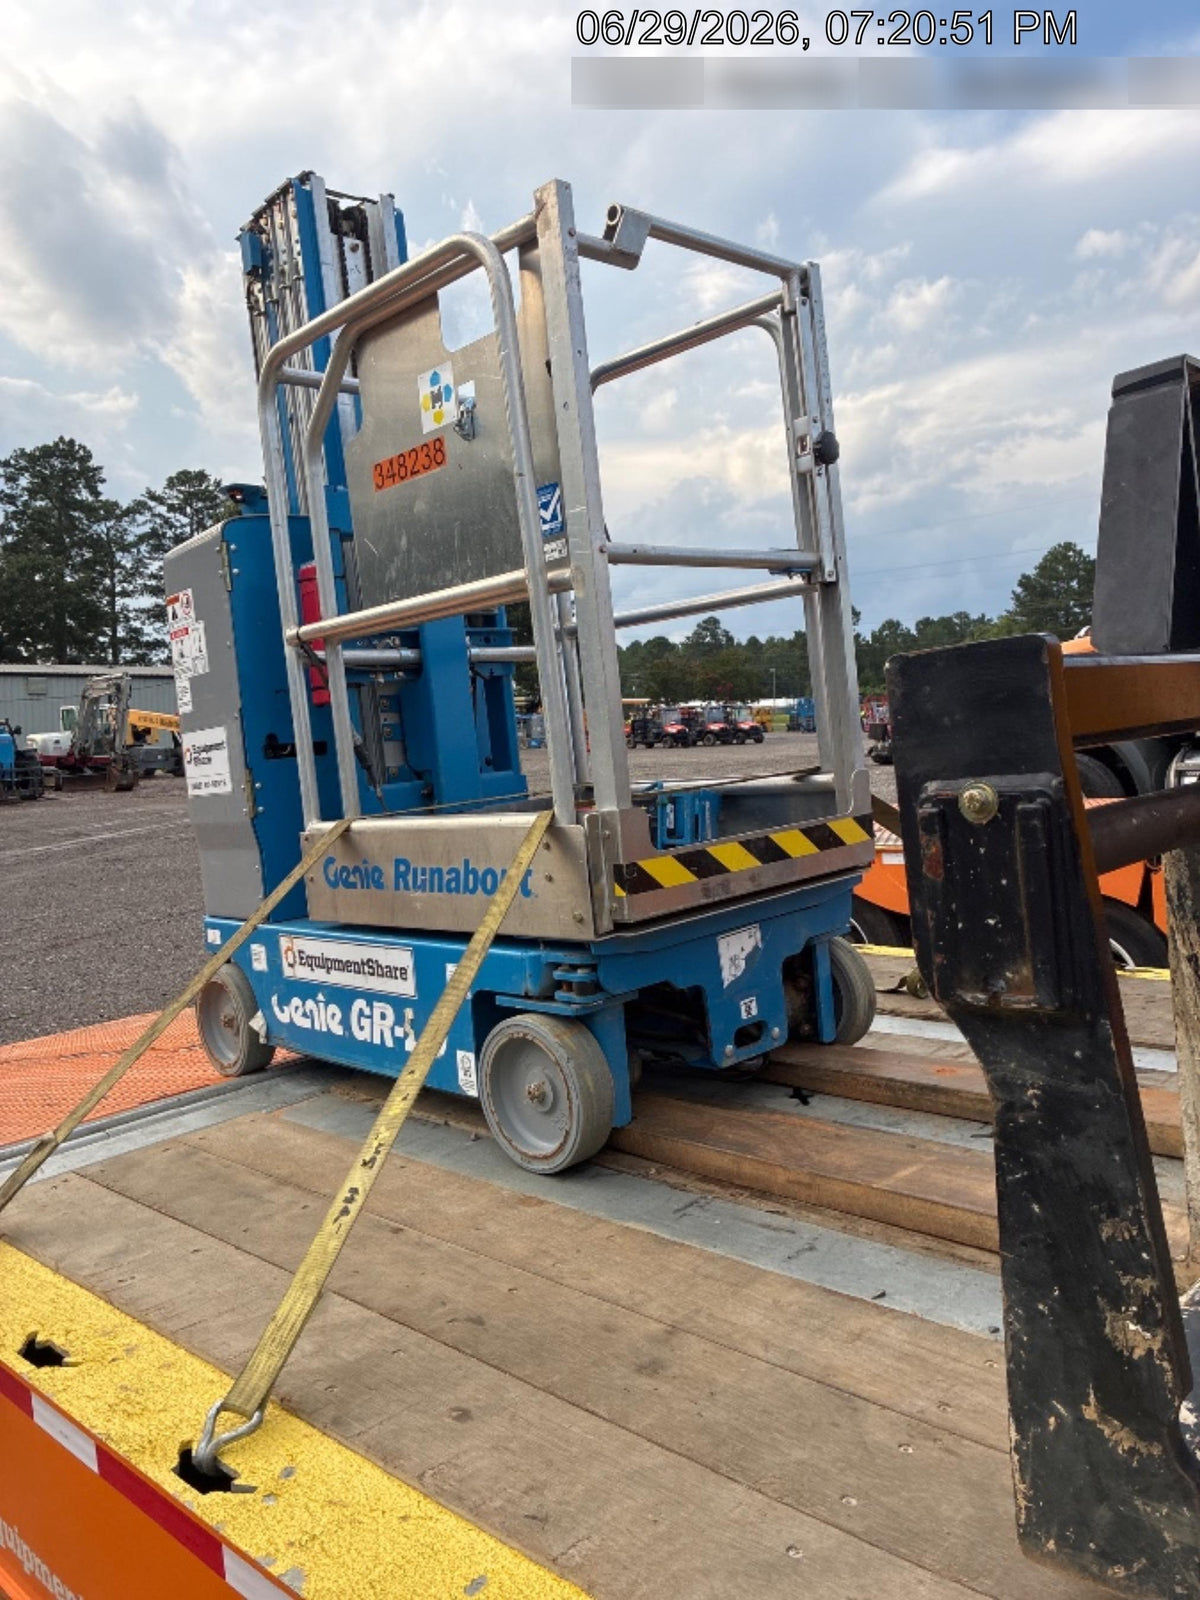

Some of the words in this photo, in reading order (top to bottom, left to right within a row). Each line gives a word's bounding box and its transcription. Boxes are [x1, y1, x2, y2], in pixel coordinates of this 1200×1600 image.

[374, 437, 445, 490] 348238
[323, 856, 386, 890] Genie
[393, 858, 534, 898] Runabot
[297, 949, 409, 982] EquipmentShare
